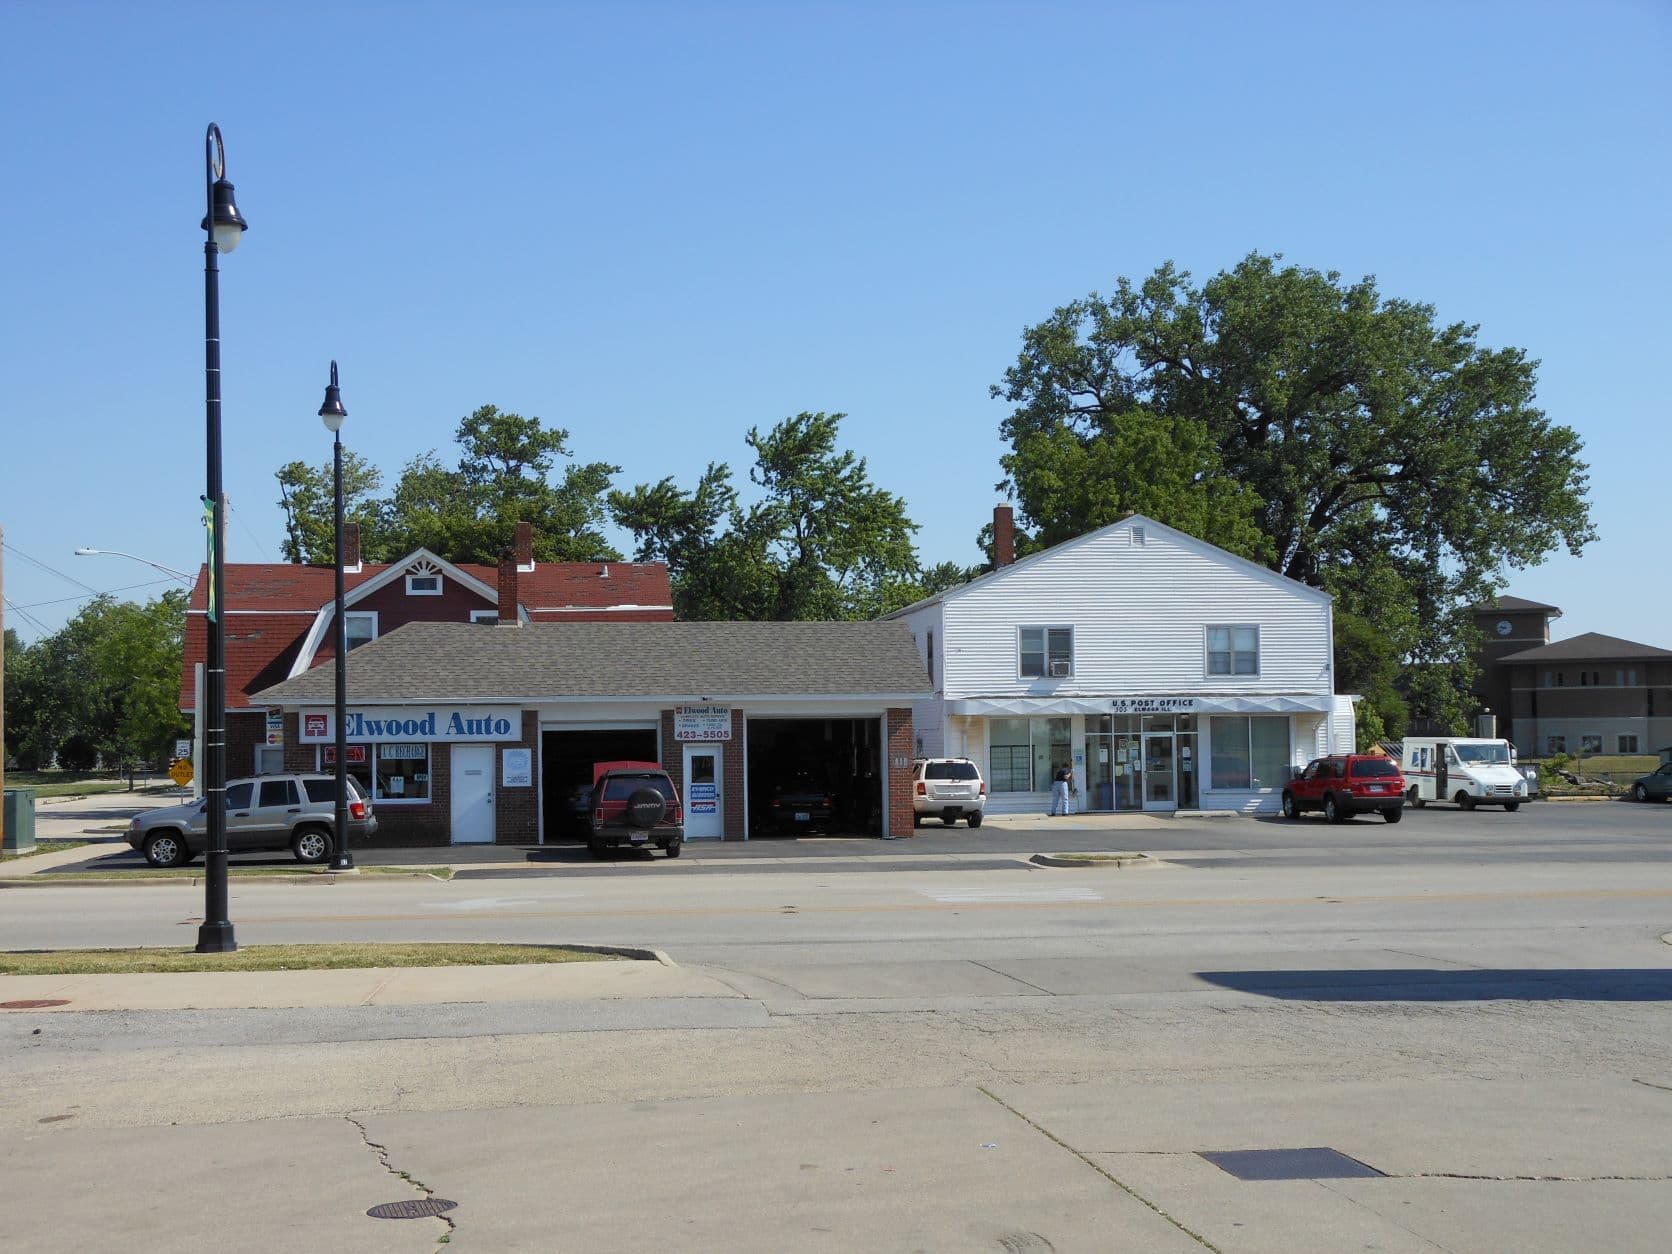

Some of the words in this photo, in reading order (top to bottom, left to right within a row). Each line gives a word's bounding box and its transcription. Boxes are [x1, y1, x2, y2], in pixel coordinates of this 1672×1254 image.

[1112, 699, 1129, 707] U.S.
[1130, 699, 1155, 707] POST
[1159, 699, 1194, 707] OFFICE
[683, 706, 710, 714] Elwood
[712, 706, 728, 714] Auto
[345, 712, 437, 736] Elwood
[446, 711, 511, 736] Auto
[676, 730, 730, 739] 423-5505
[177, 748, 189, 756] 25
